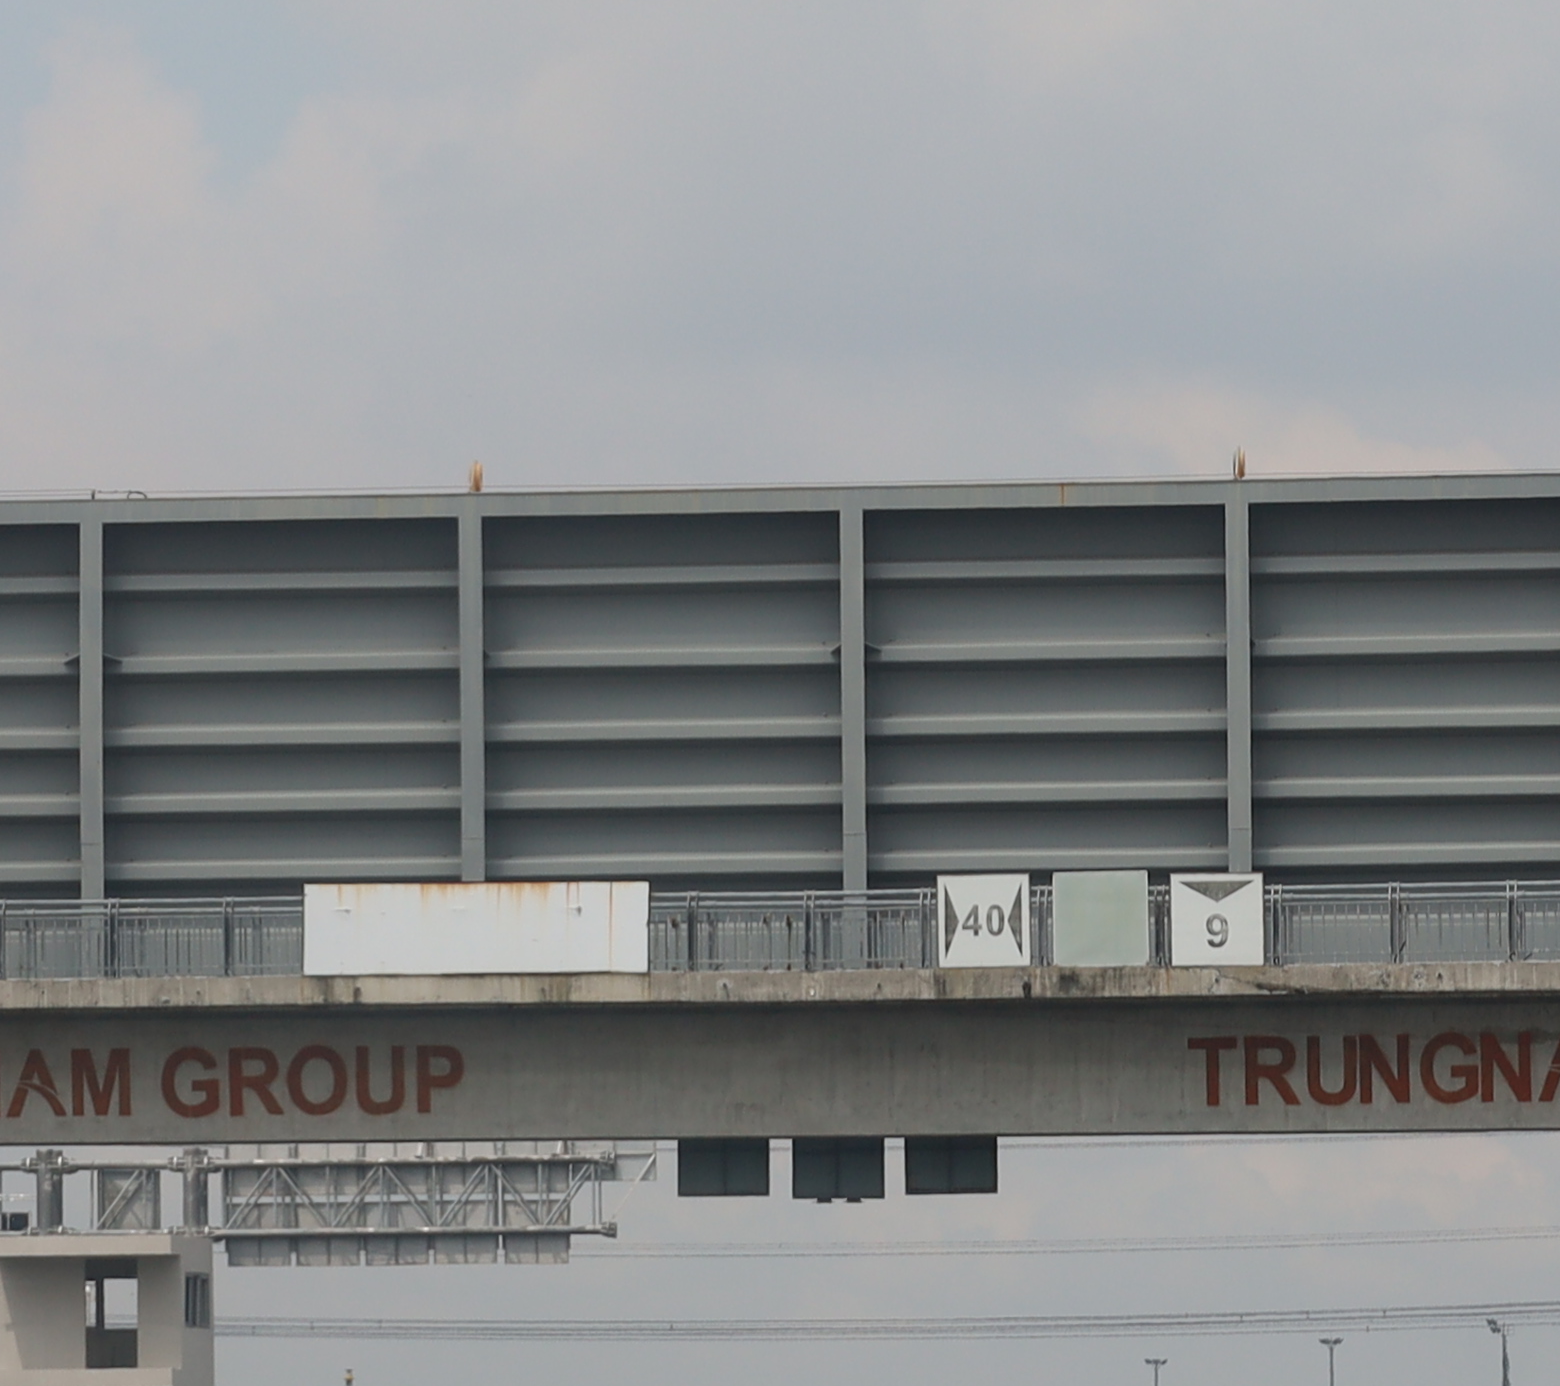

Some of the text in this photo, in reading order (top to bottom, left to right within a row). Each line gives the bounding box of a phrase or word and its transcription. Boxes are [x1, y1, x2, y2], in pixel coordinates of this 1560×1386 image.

[961, 904, 1006, 937] 40
[1205, 913, 1229, 948] 9
[160, 1044, 465, 1120] GROUP
